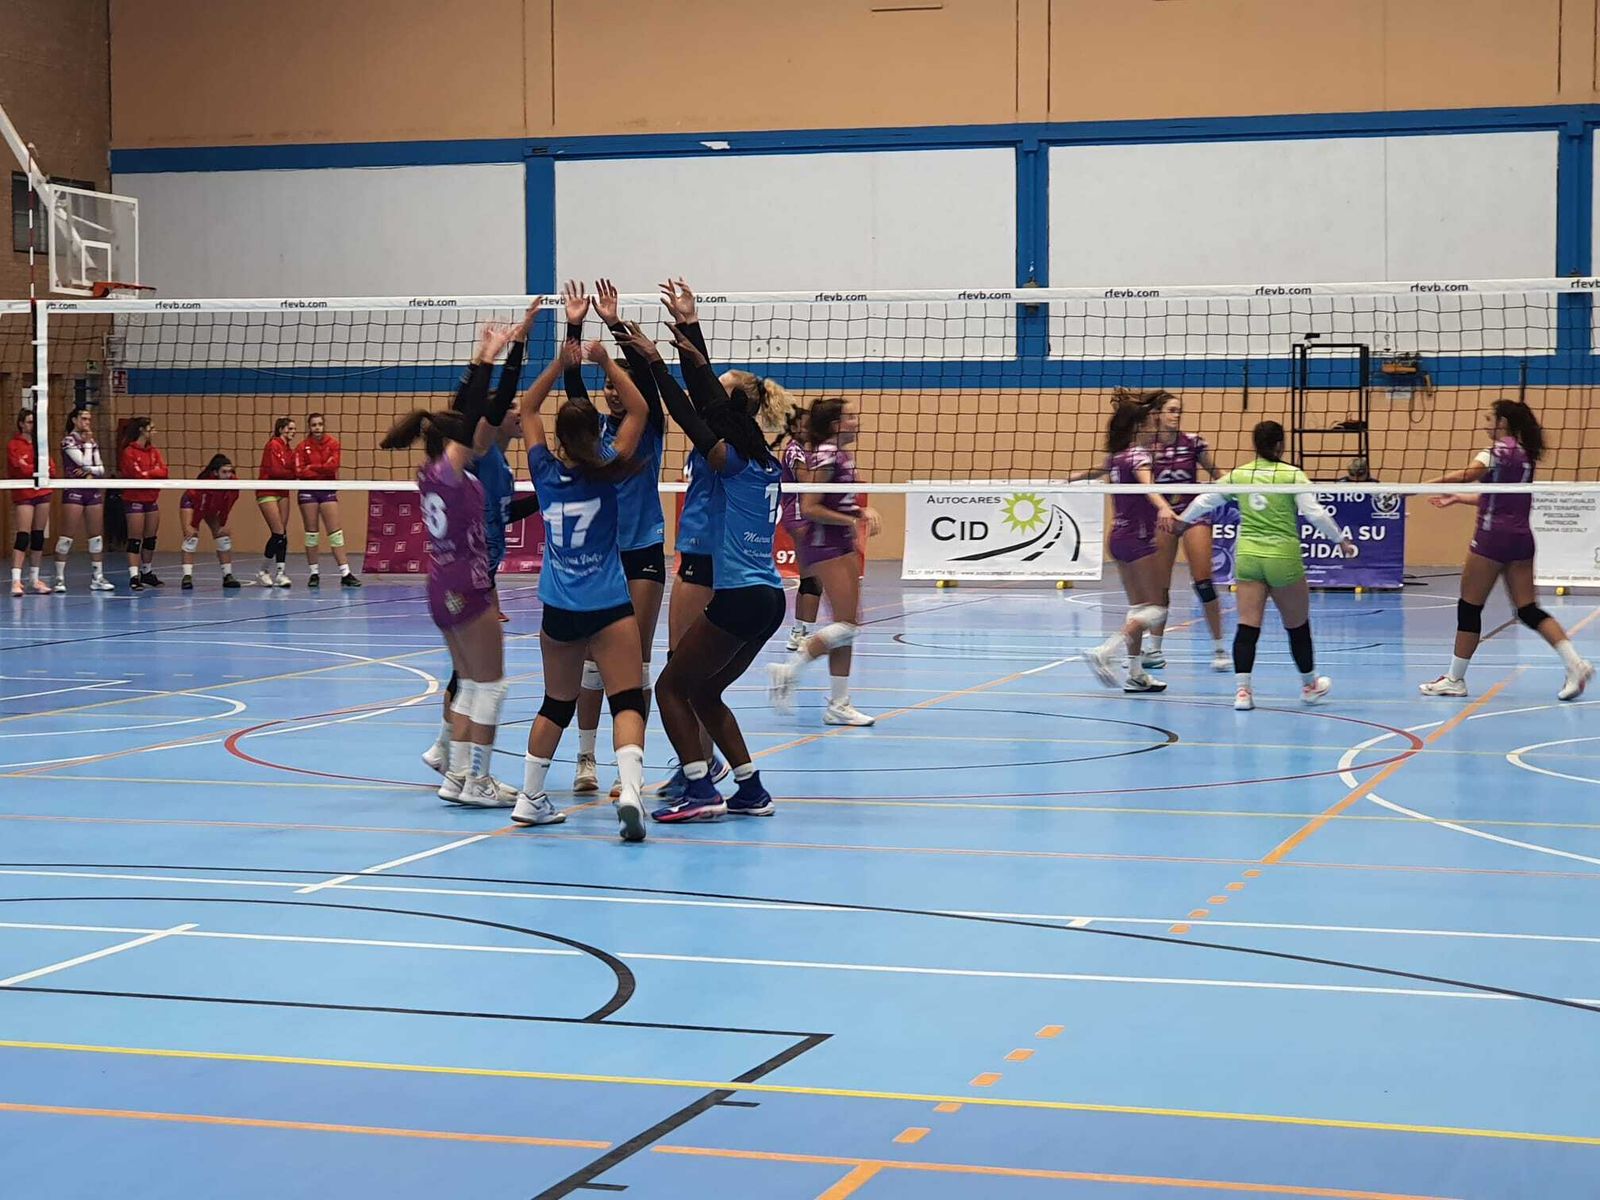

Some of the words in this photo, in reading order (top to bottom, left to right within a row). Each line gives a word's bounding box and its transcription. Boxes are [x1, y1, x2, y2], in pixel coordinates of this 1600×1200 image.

[1105, 288, 1160, 298] rfevb.com
[1255, 286, 1312, 297] rfevb.com
[1410, 283, 1469, 294] rfevb.com
[695, 293, 727, 304] b.com
[815, 292, 868, 302] rfevb.com
[958, 290, 1012, 300] rfevb.com
[155, 300, 202, 310] rfevb.com
[280, 299, 328, 309] rfevb.com
[408, 298, 457, 308] rfevb.com
[926, 494, 1002, 505] AUTOCARES
[1316, 492, 1365, 503] ESTRO
[543, 497, 601, 548] 17
[931, 516, 989, 541] CID
[1358, 526, 1386, 541] SU
[776, 550, 796, 564] 97
